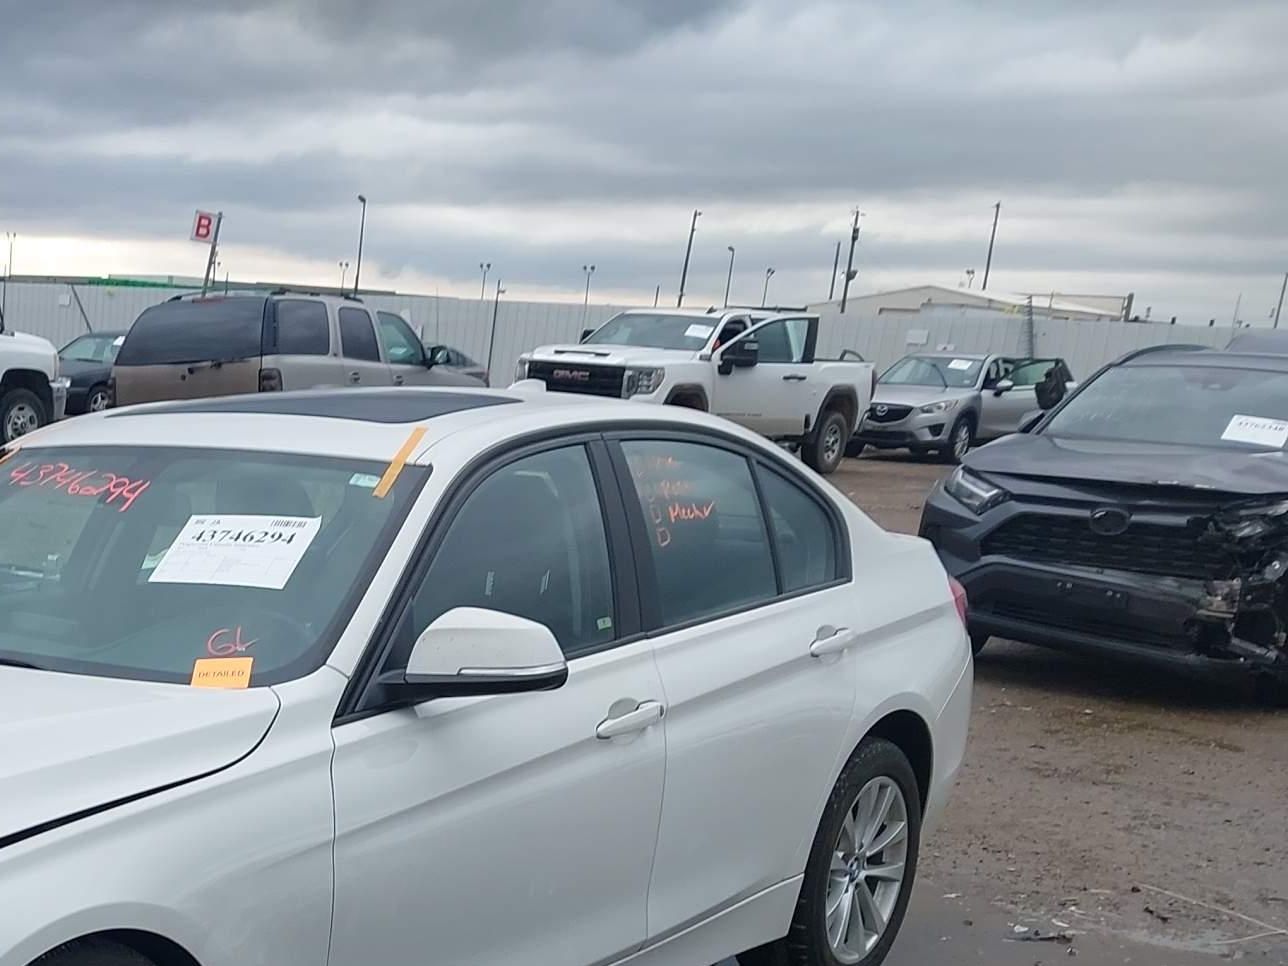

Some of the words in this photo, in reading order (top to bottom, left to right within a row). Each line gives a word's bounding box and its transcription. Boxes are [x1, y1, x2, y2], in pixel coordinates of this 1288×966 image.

[195, 215, 212, 239] B
[552, 369, 590, 381] GMC
[191, 529, 297, 545] 43746294
